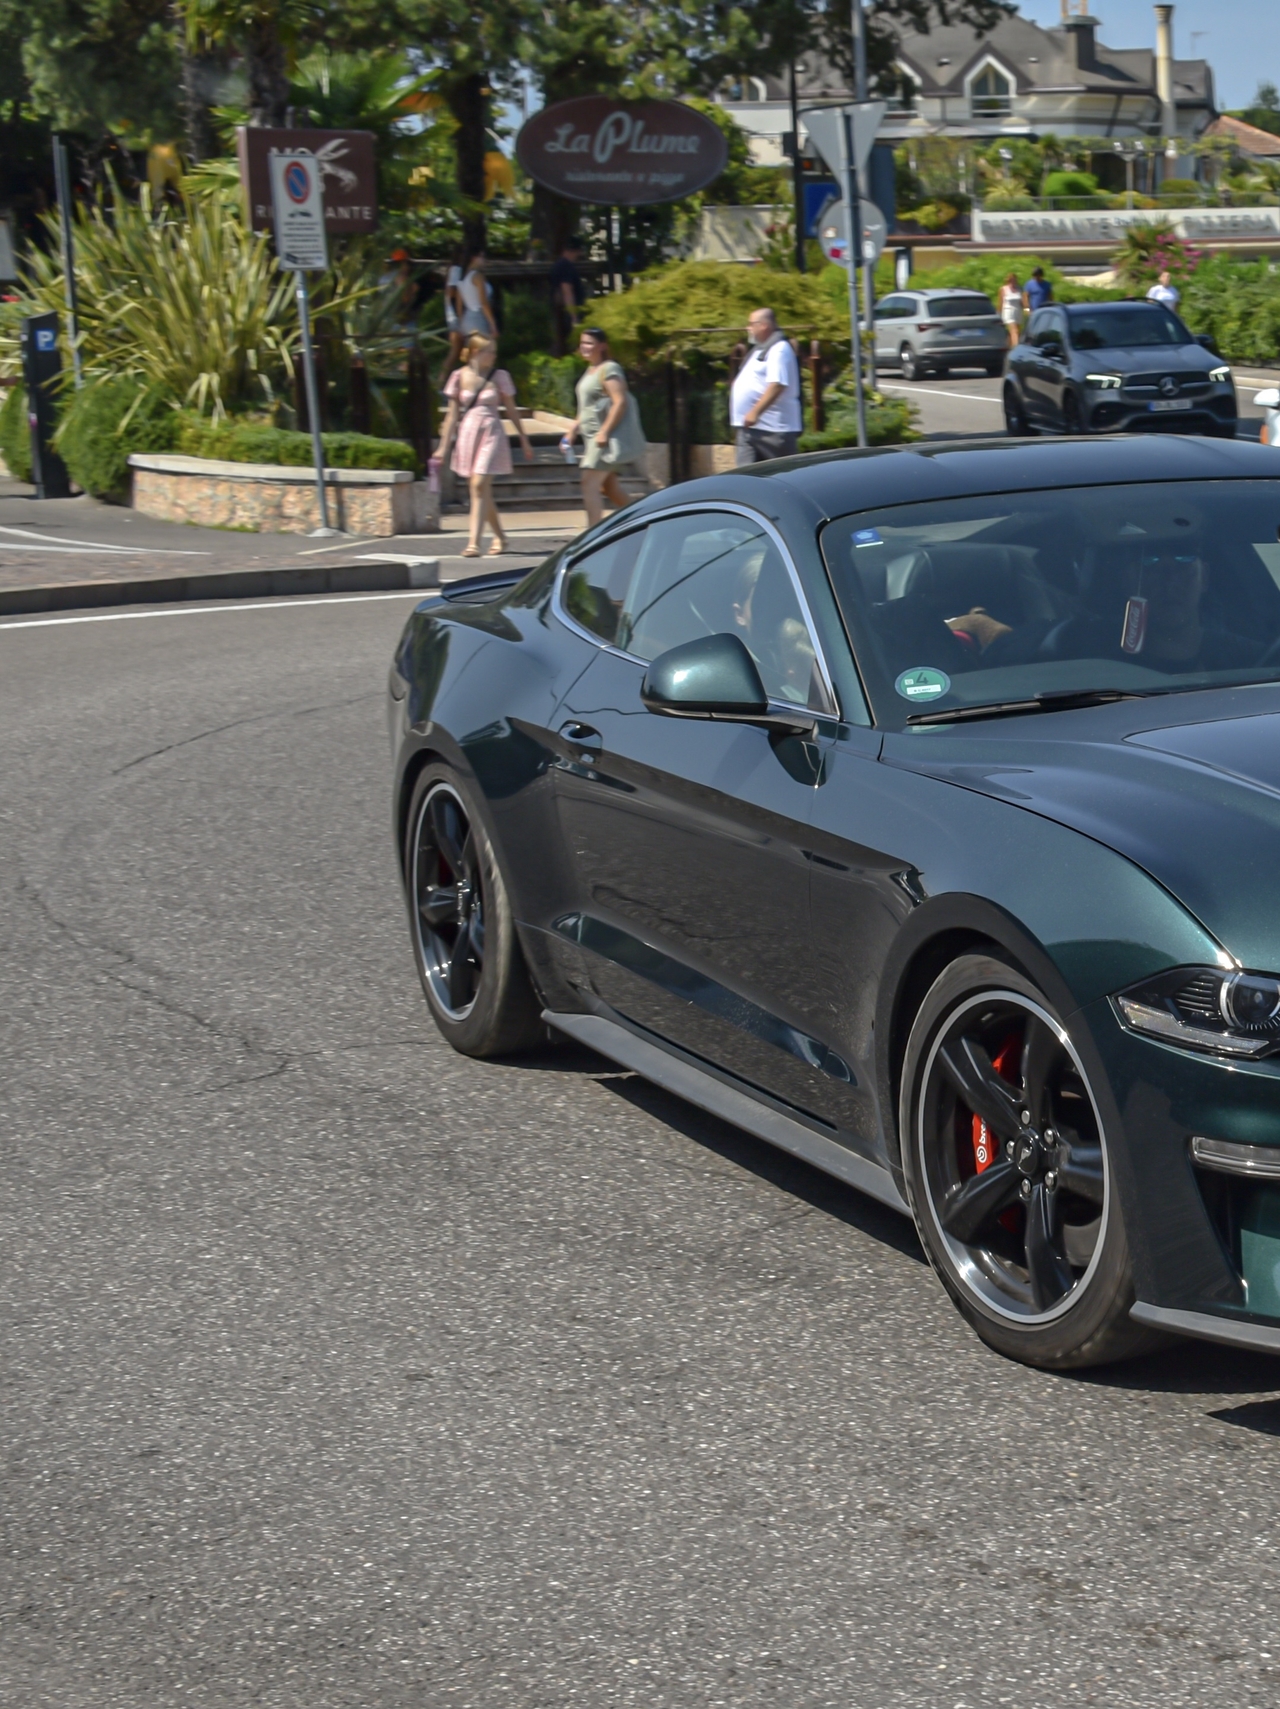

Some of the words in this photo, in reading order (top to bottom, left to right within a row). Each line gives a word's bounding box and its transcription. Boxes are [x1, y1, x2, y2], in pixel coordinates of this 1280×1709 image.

[544, 122, 591, 153] La
[593, 111, 701, 163] Plume
[256, 204, 373, 220] RIANTE
[37, 331, 54, 348] P
[916, 672, 929, 684] 4
